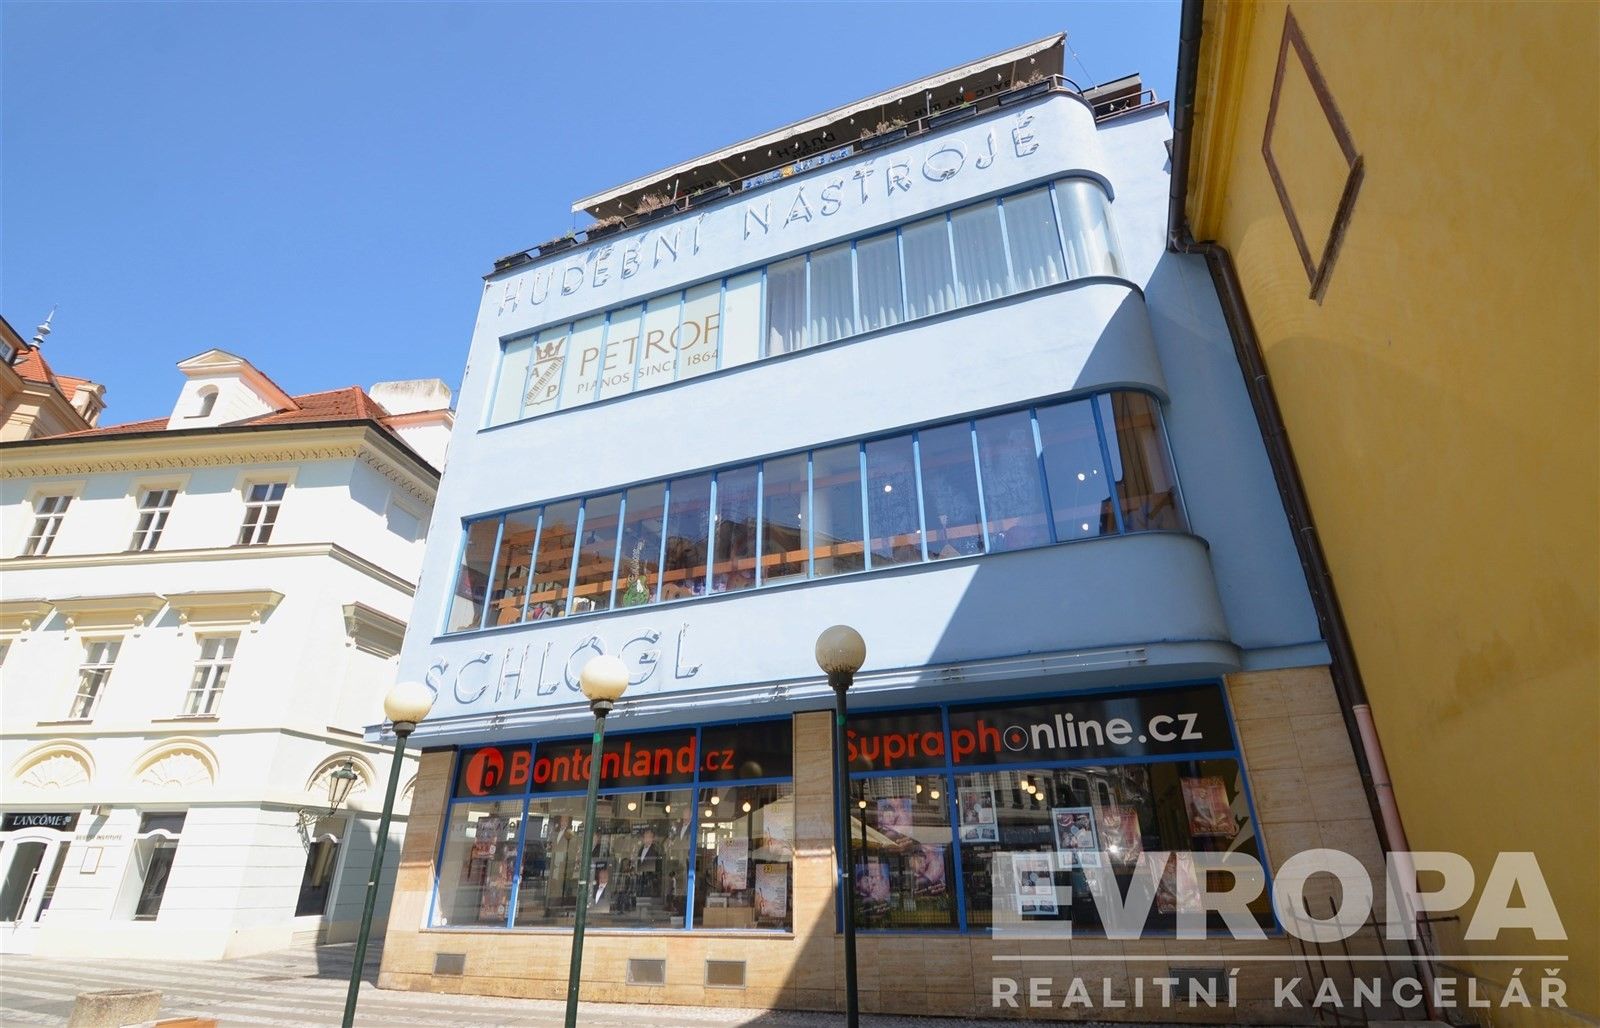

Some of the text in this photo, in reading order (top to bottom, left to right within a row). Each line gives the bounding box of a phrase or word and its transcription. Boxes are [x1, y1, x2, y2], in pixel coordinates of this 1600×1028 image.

[579, 313, 720, 377] PETROF
[576, 371, 630, 394] PIANOS
[687, 348, 718, 367] 1864
[13, 814, 62, 826] LANCÔME
